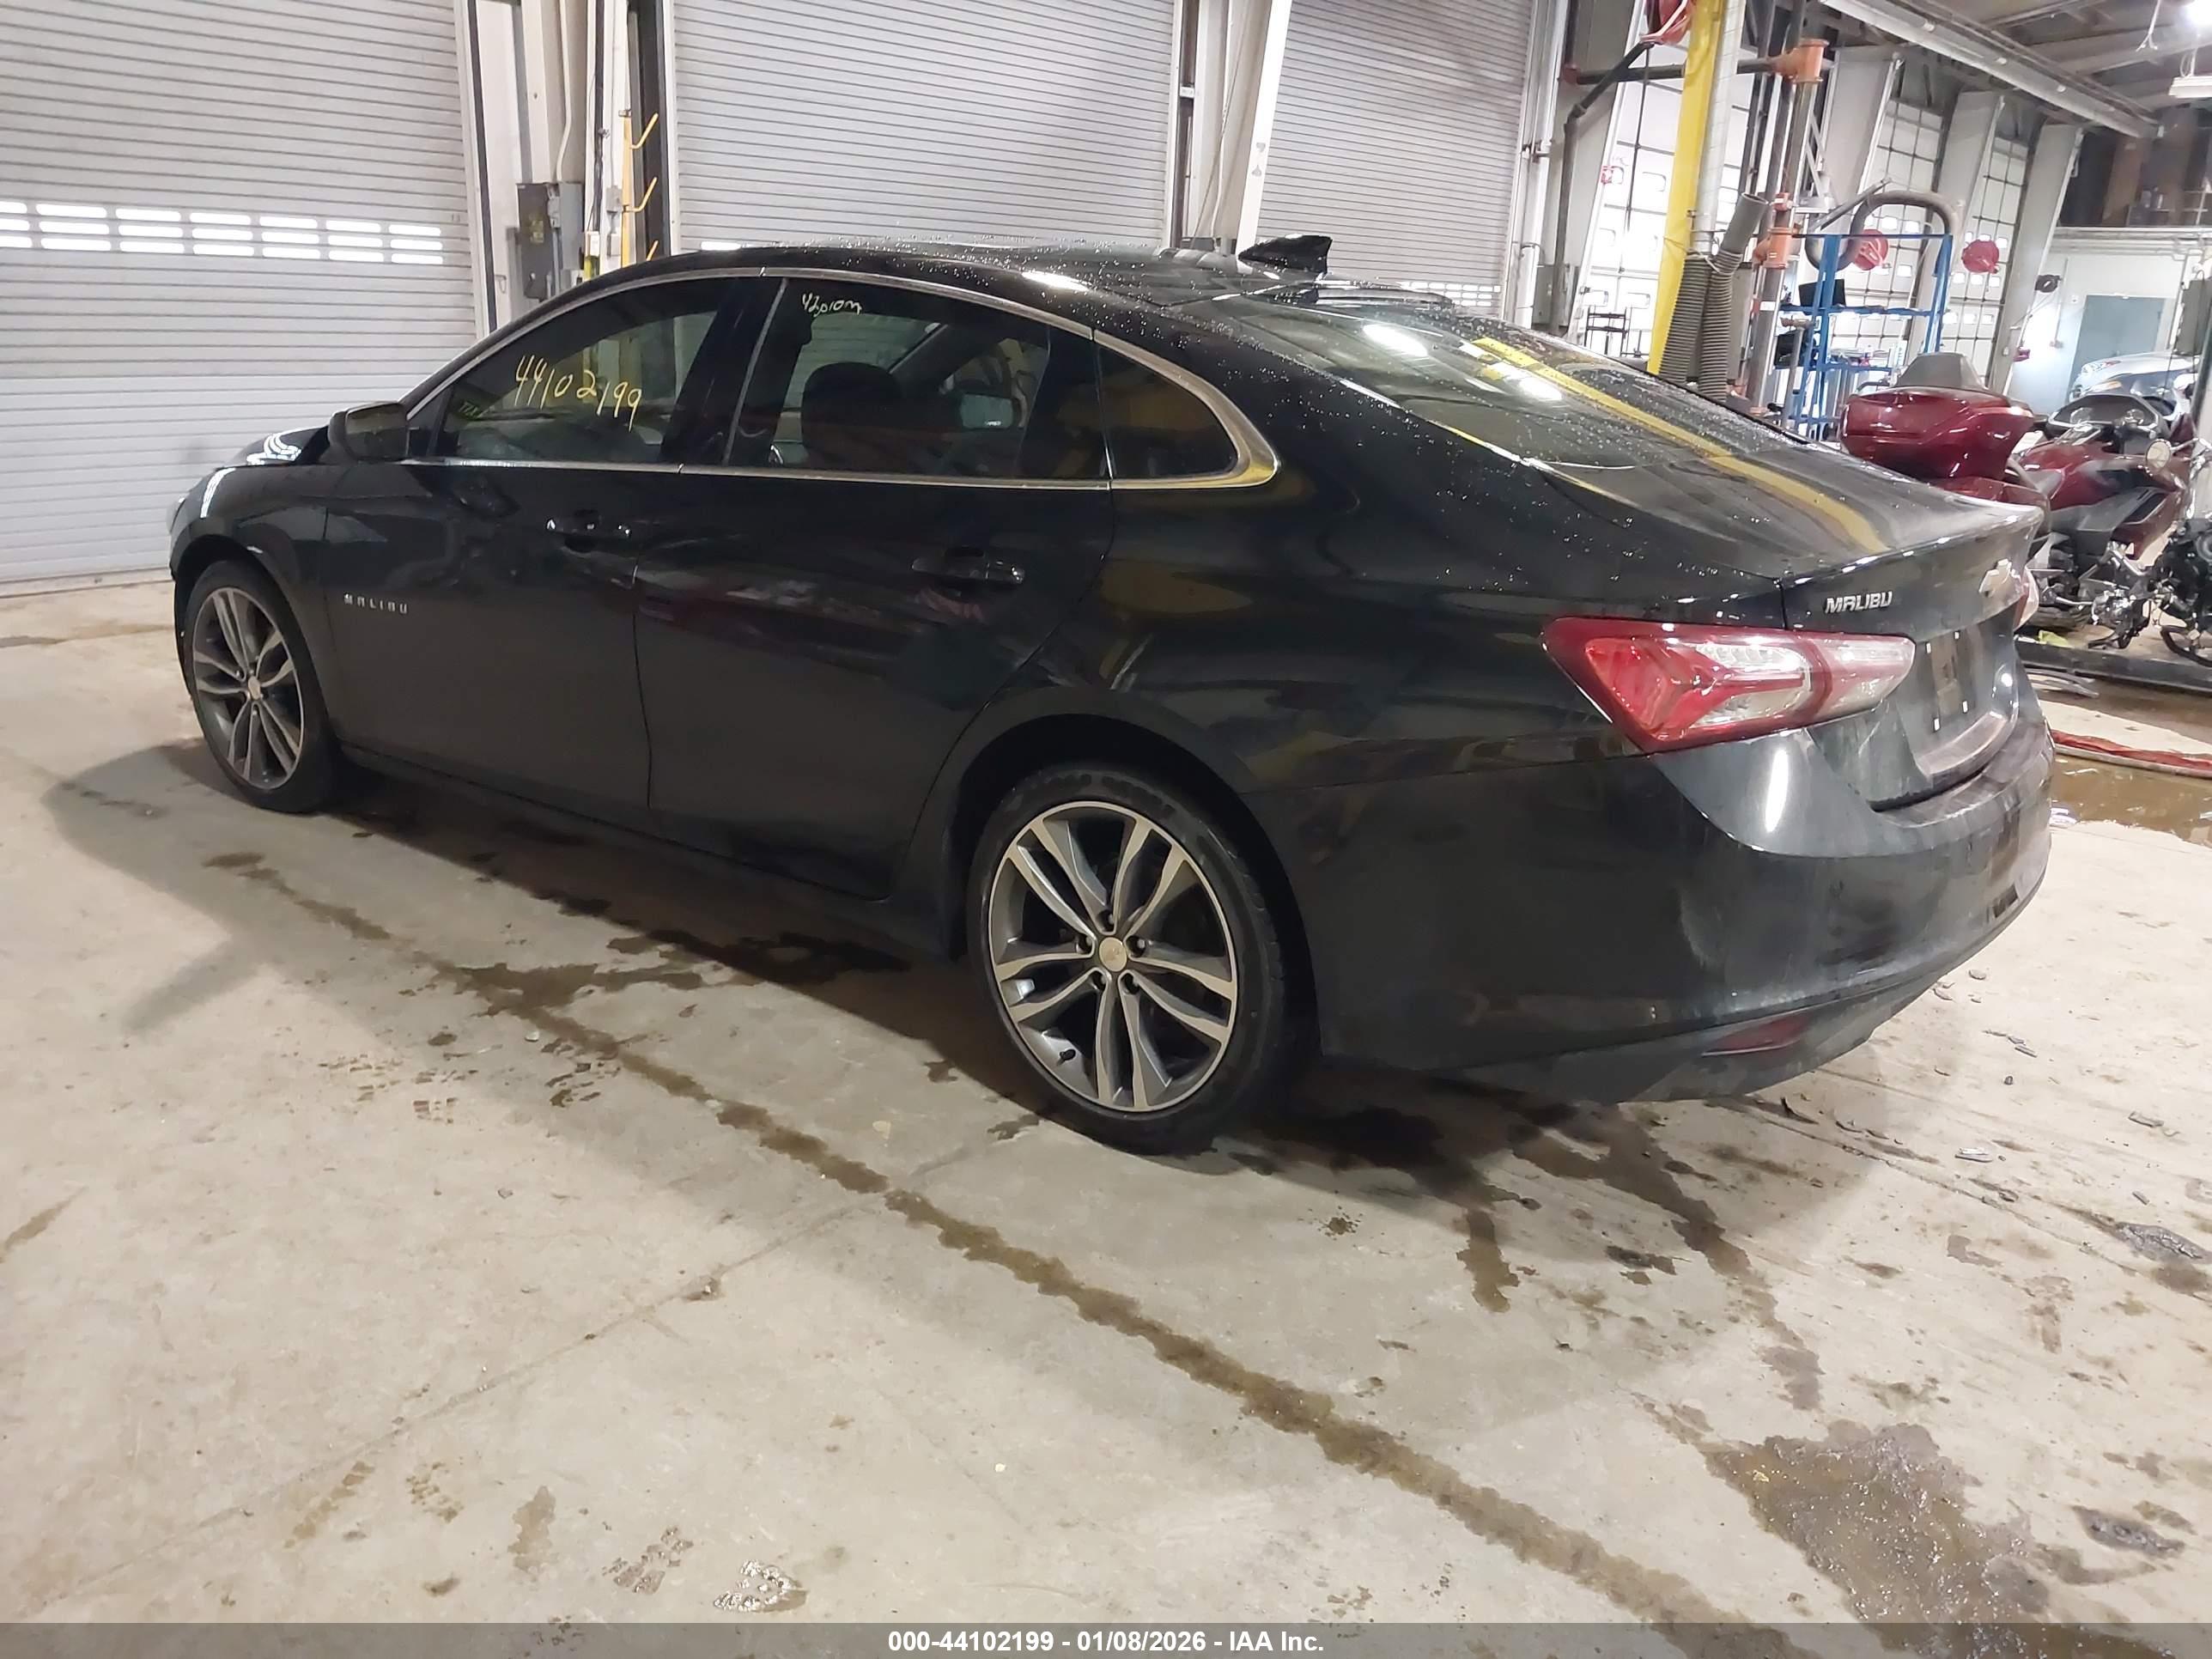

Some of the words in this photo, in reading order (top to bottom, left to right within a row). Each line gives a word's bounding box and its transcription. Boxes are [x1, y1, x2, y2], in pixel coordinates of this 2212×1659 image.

[514, 355, 642, 432] 44102199
[343, 593, 408, 615] MALIBU
[1825, 591, 1893, 614] MALIBU
